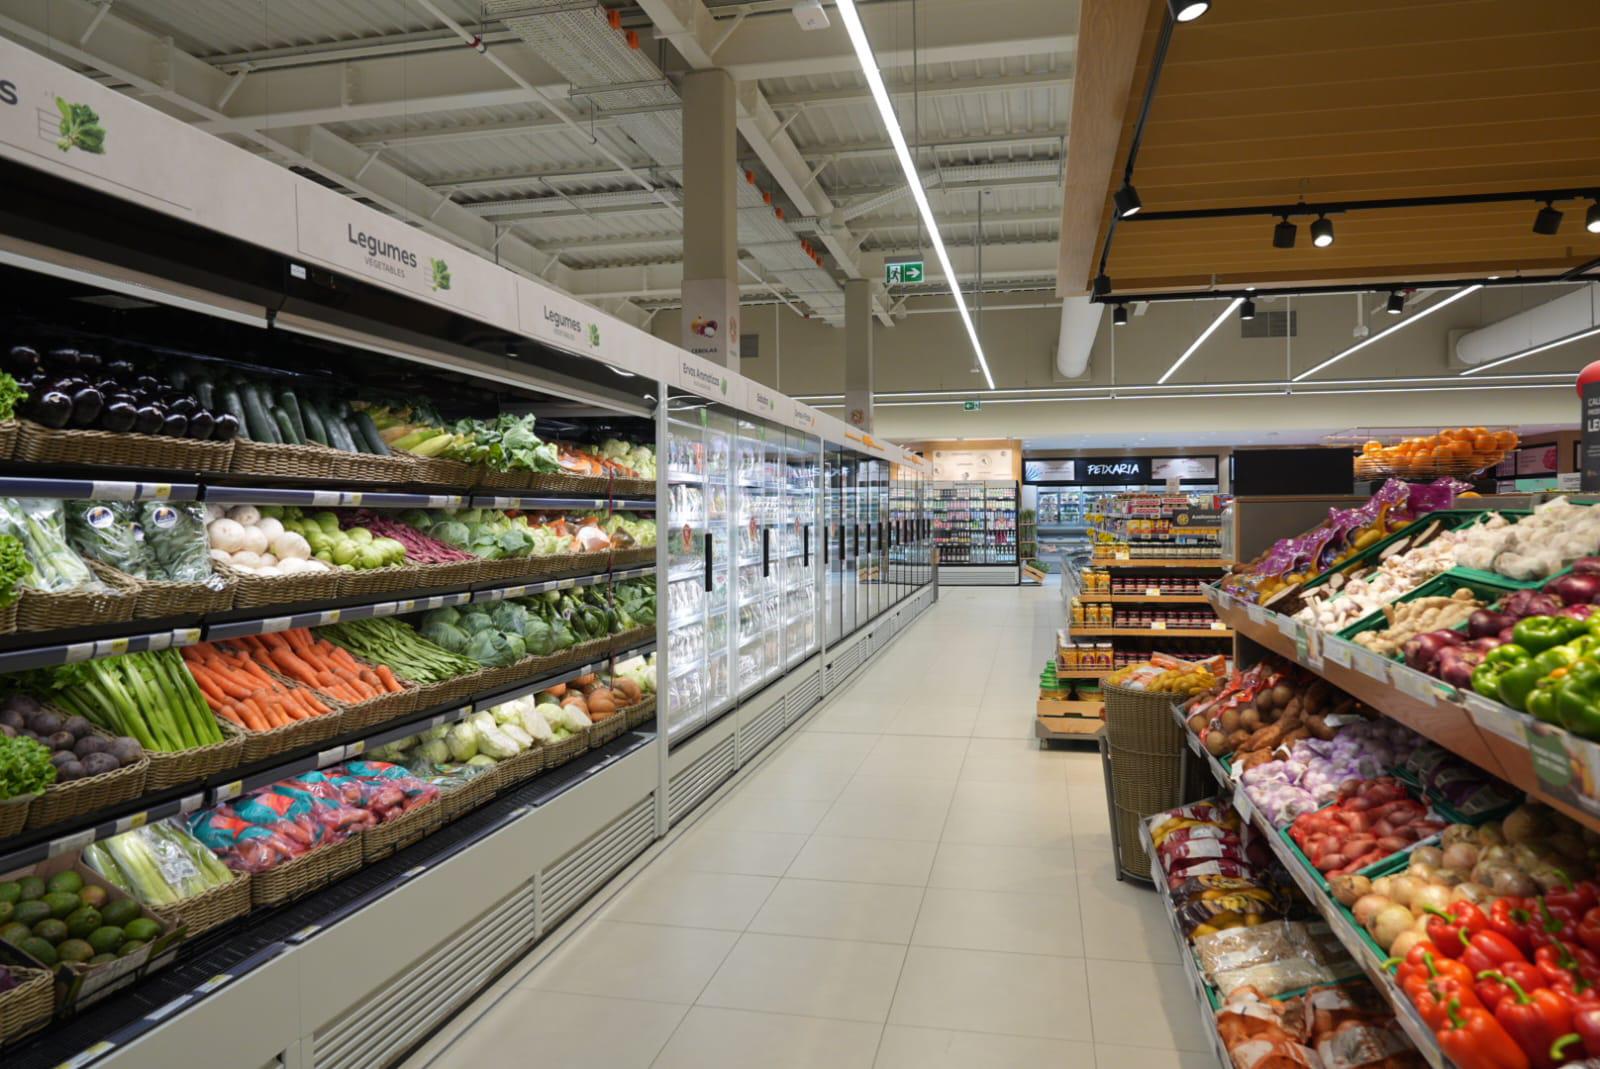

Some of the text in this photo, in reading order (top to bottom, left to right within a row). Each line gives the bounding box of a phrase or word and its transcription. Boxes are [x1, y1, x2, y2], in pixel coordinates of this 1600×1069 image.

[347, 222, 418, 268] Legumes
[363, 256, 406, 278] VEGETABLES
[543, 304, 582, 333] Legumes
[1087, 463, 1140, 475] PEIXARIA
